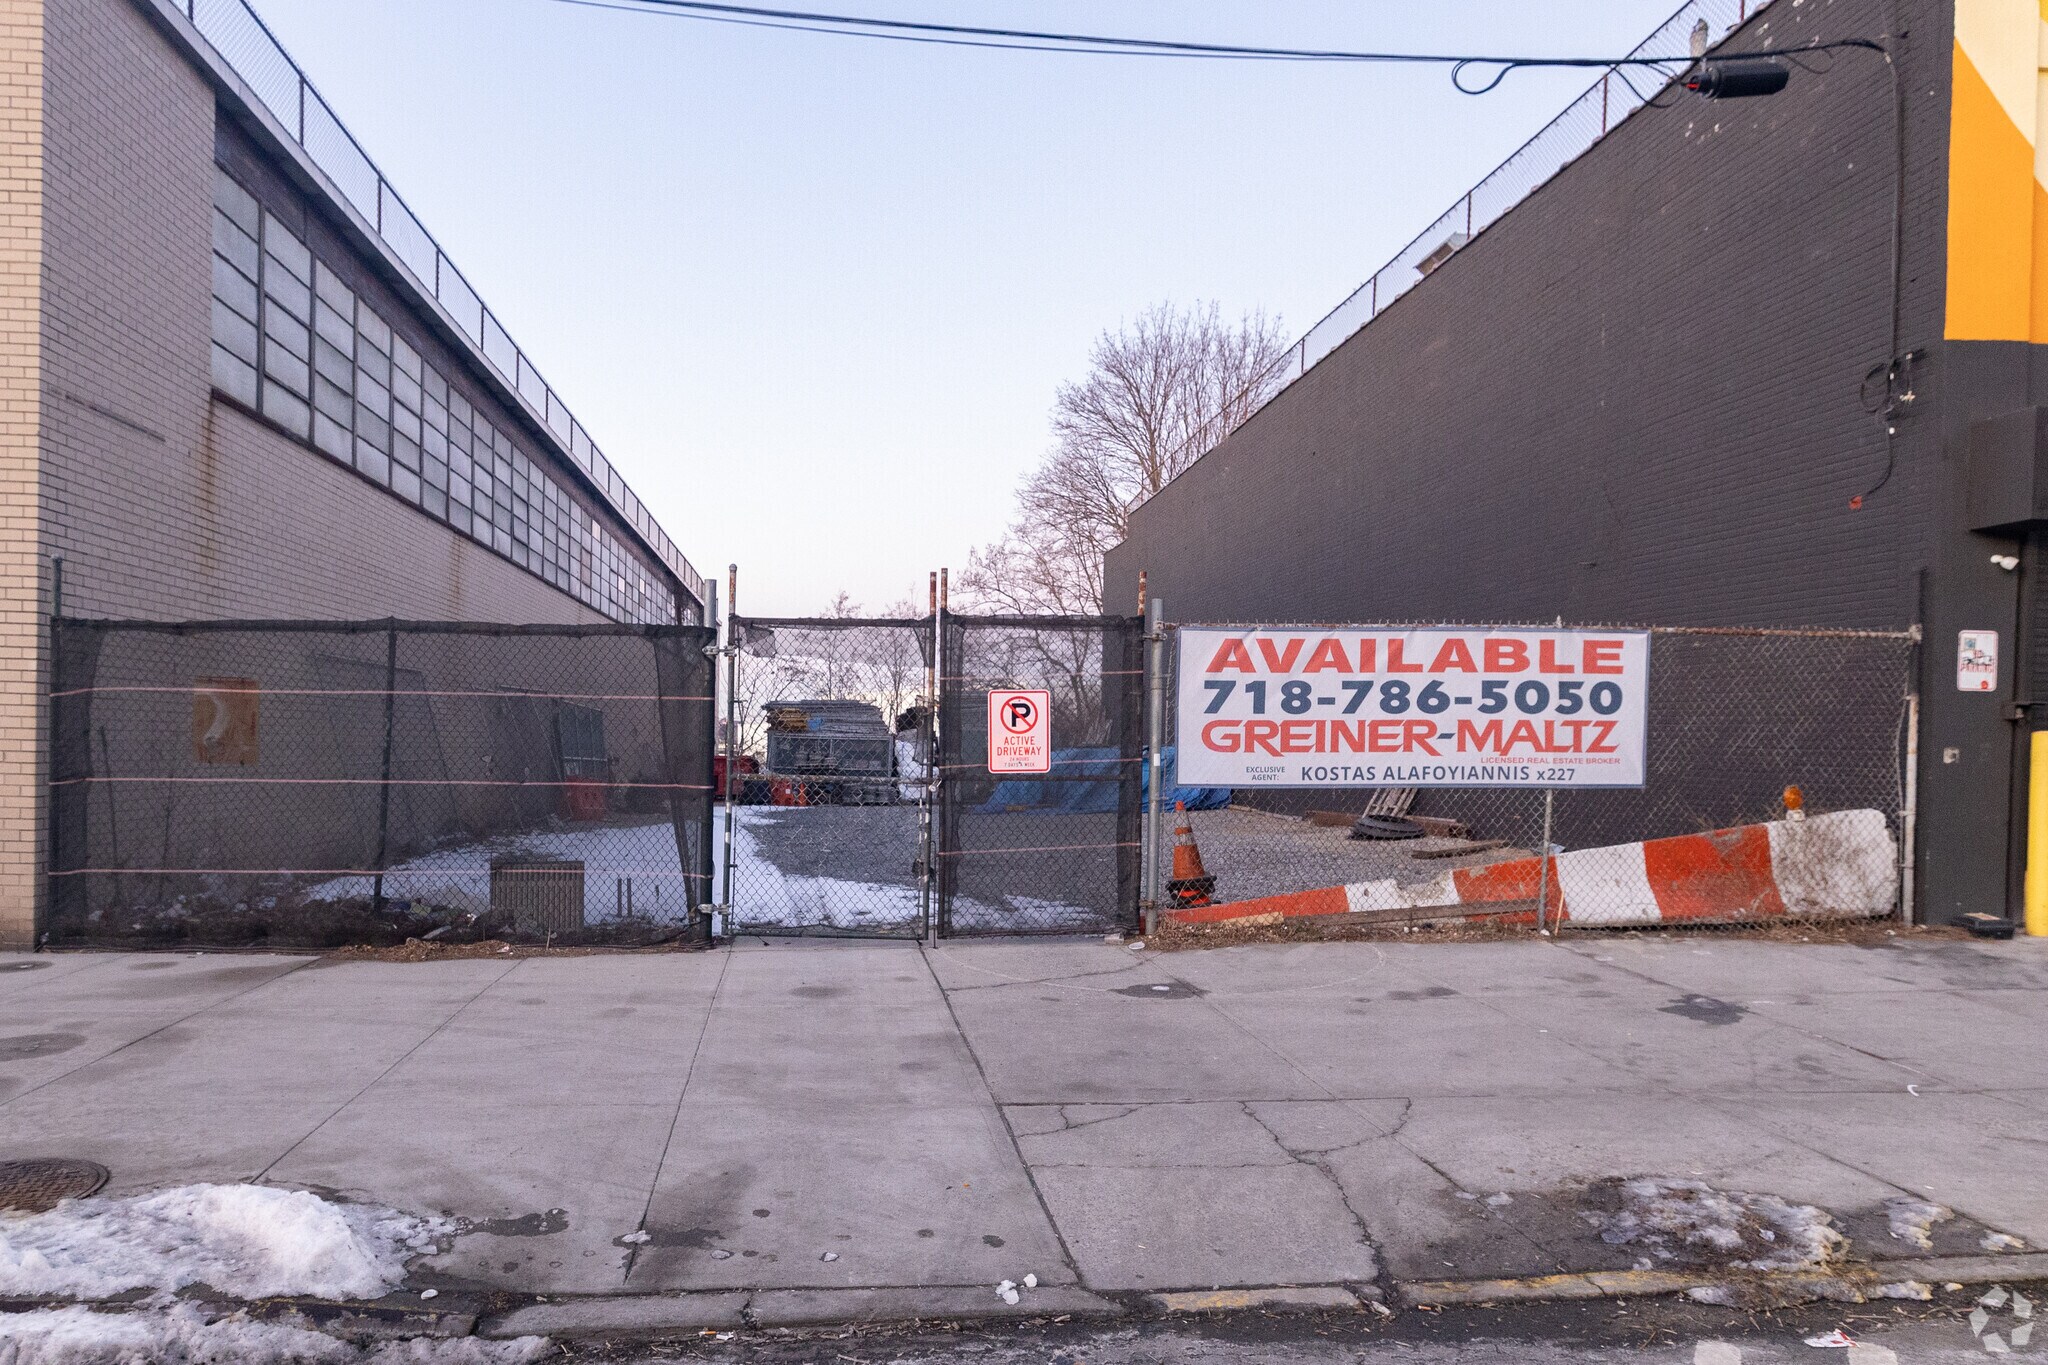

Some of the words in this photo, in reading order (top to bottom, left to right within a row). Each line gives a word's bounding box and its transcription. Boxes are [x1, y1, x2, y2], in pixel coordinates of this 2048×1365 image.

[1205, 638, 1624, 674] AVAILABLE
[1203, 680, 1623, 715] 718-786-5050
[1004, 736, 1035, 745] ACTIVE
[1201, 719, 1620, 757] GREINER-MALTZ
[997, 747, 1041, 756] DRIVEWAY
[1302, 766, 1376, 781] KOSTAS
[1383, 766, 1529, 780] ALAFOYIANNIS
